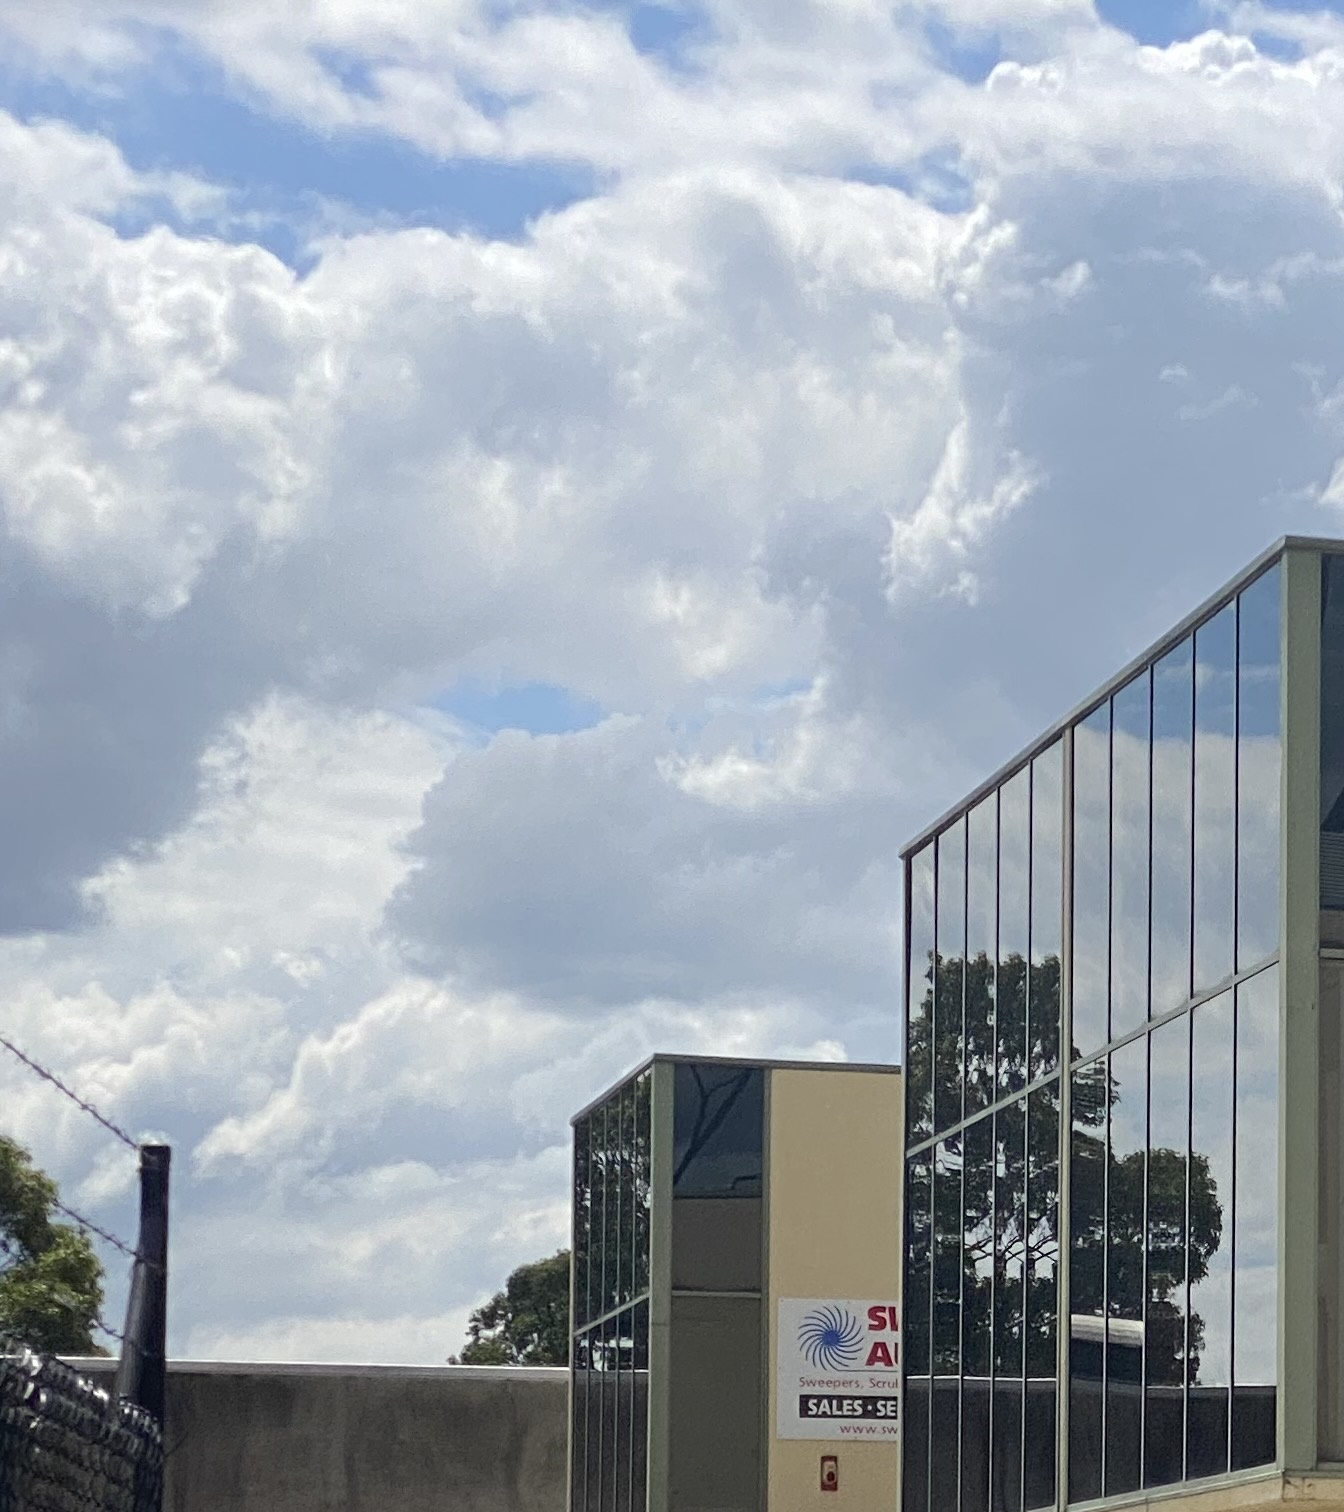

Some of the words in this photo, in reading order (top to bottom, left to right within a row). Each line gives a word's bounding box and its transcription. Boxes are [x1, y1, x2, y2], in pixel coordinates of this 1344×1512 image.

[865, 1342, 898, 1367] A
[799, 1376, 864, 1389] Sweepers,
[870, 1377, 898, 1389] Scru
[808, 1398, 863, 1416] SALES
